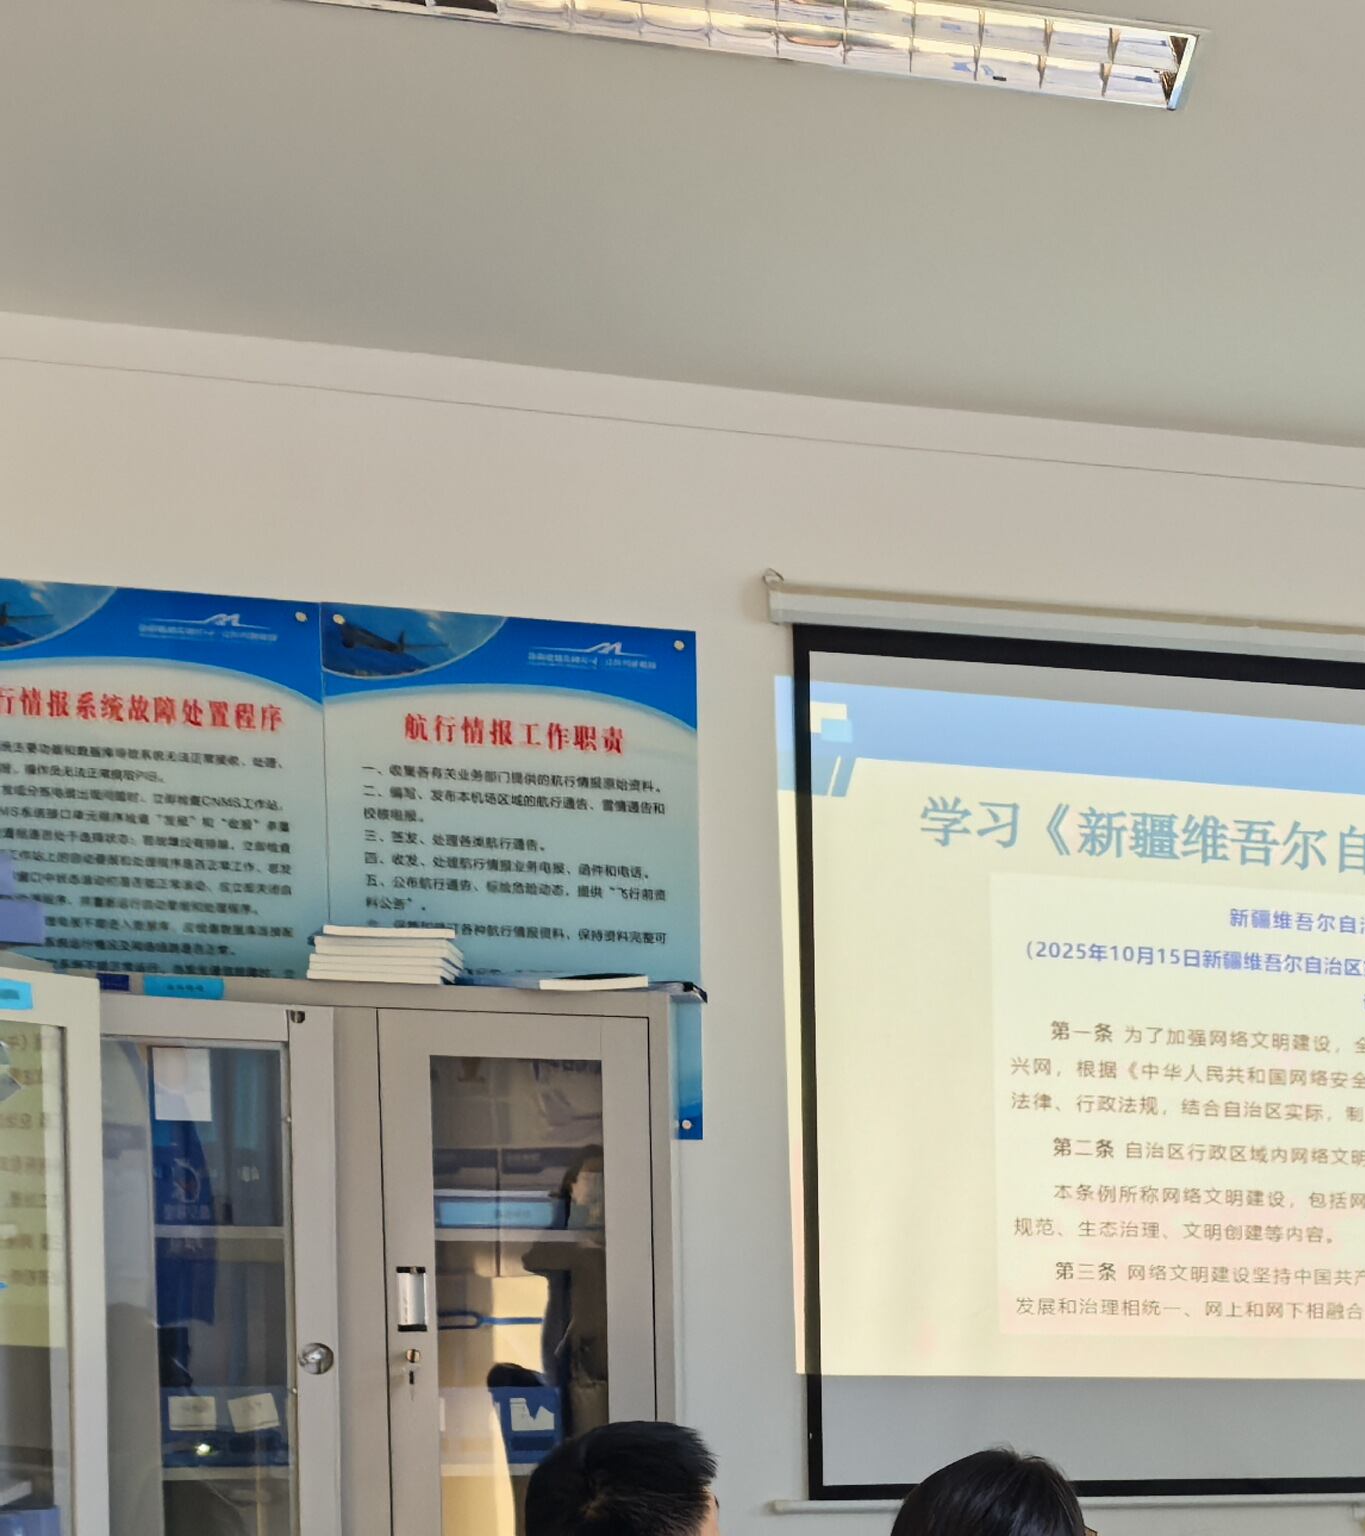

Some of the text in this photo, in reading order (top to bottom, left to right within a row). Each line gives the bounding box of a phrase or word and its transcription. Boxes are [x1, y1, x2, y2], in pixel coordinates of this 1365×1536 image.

[404, 712, 625, 755] 航行情报工作职责
[1051, 1020, 1114, 1044] 第一条
[1052, 1136, 1115, 1159] 第二条
[1055, 1261, 1117, 1282] 第三条
